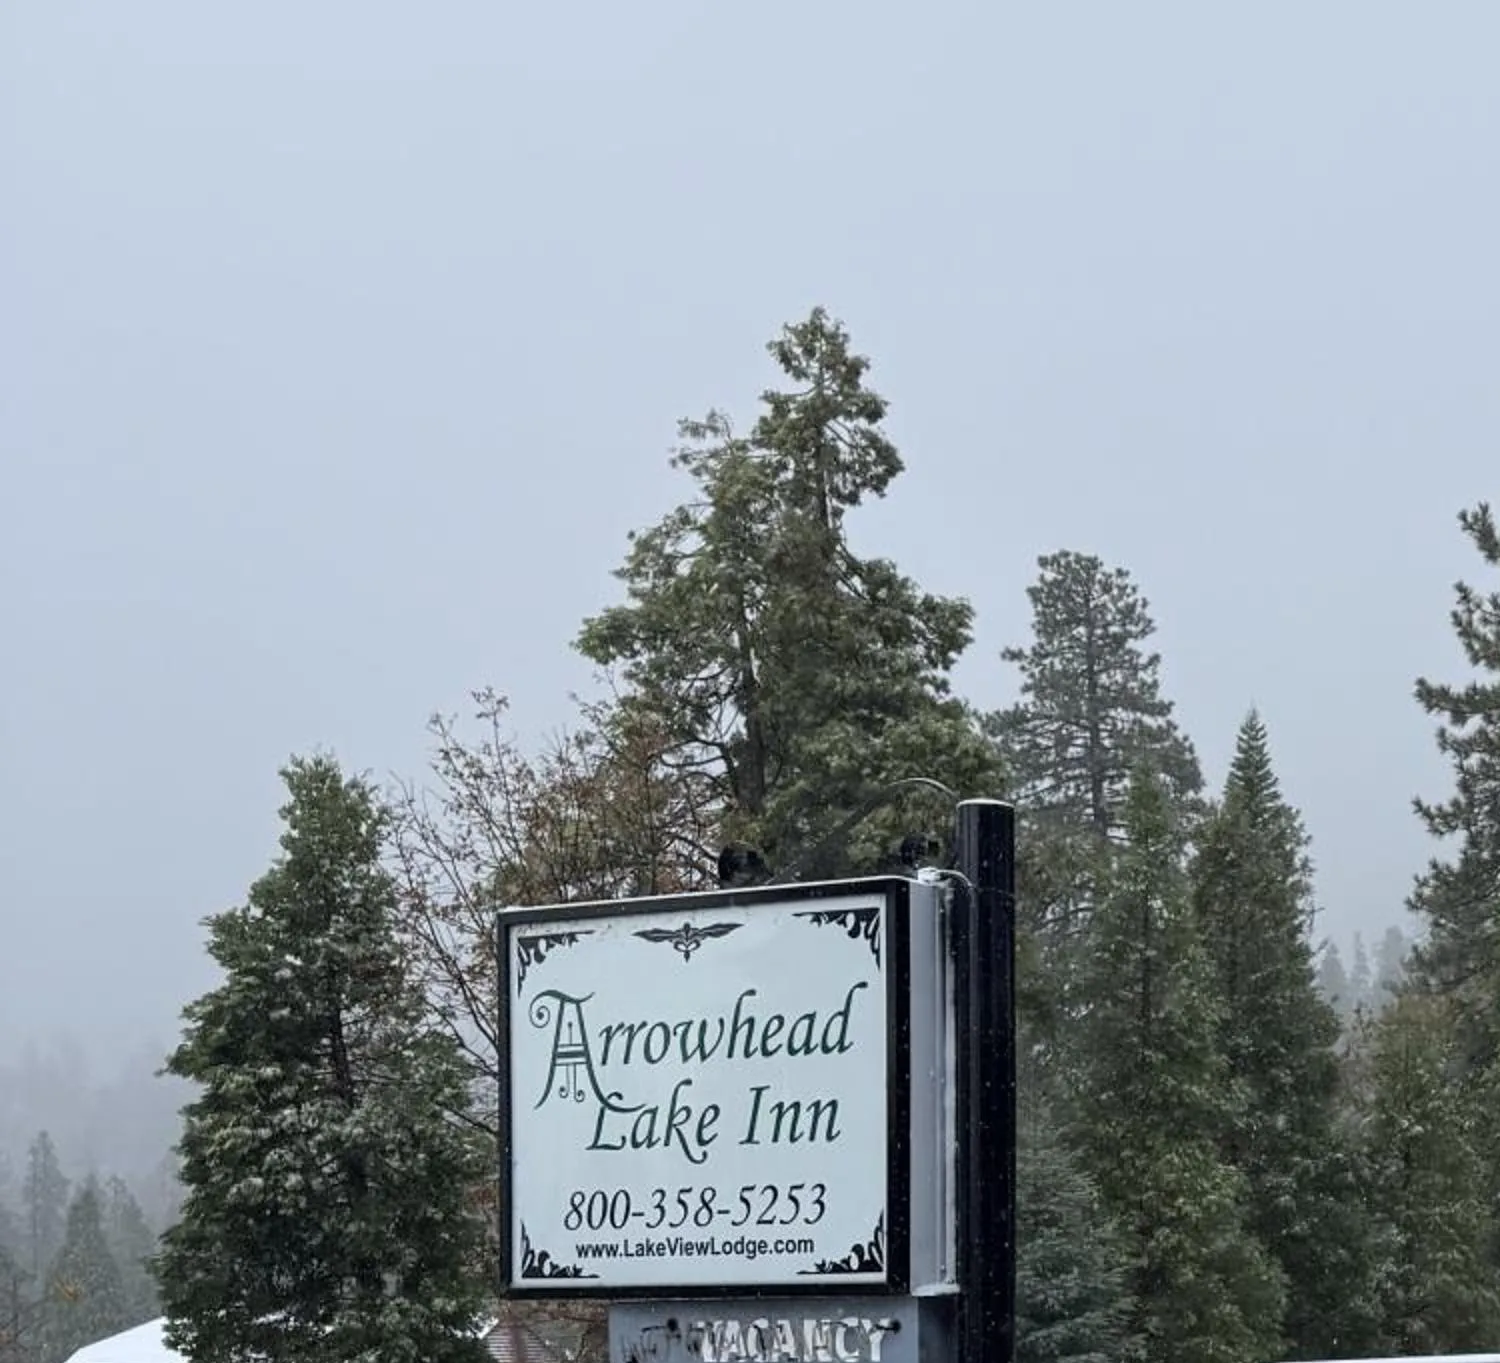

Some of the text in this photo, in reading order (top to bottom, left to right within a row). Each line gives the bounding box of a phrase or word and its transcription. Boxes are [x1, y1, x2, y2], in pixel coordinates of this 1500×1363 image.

[529, 981, 869, 1110] Arrowhead
[584, 1078, 842, 1165] Lake Inn
[563, 1182, 828, 1232] 800-358-5253
[575, 1235, 816, 1260] www.LakeViewLodge.com
[697, 1316, 890, 1363] VACANCY
